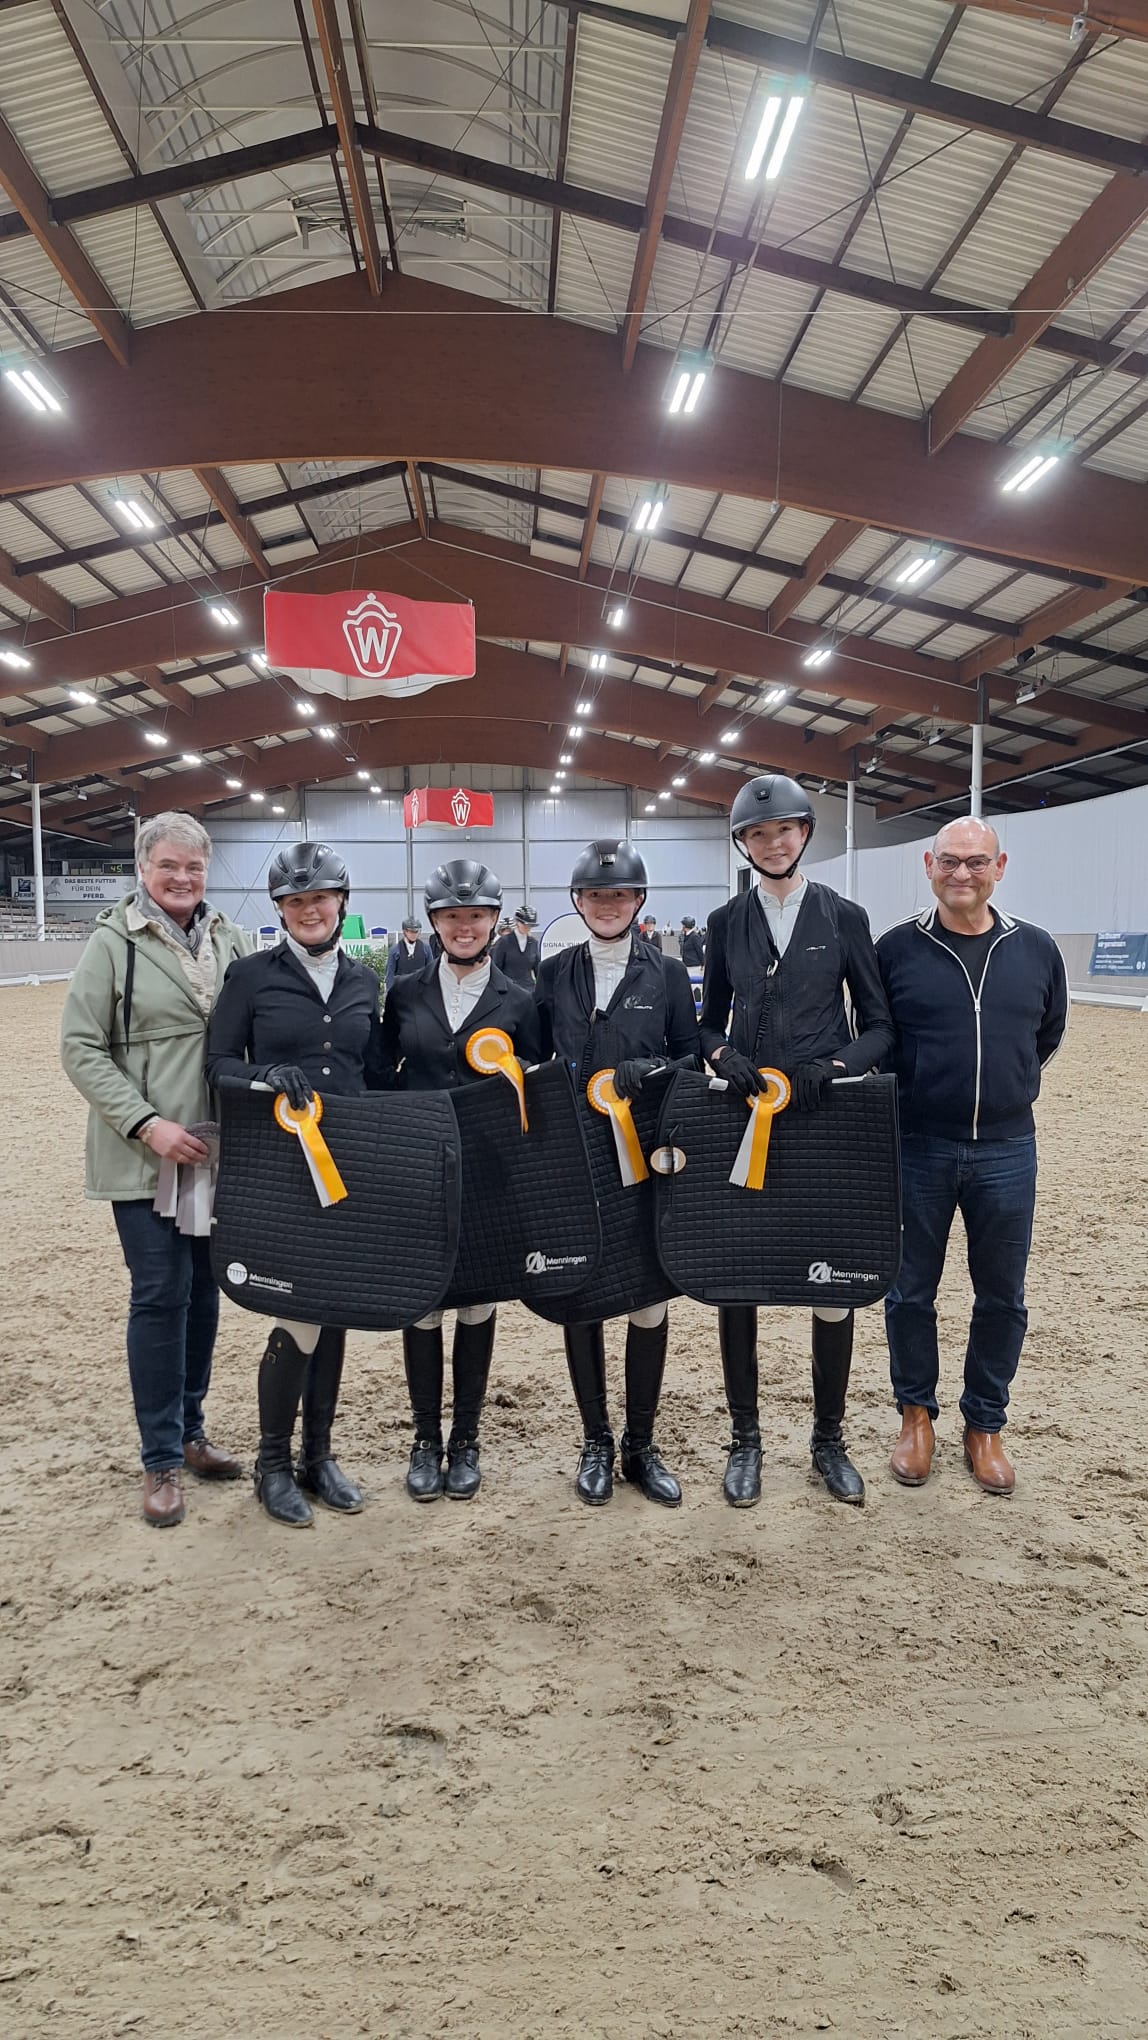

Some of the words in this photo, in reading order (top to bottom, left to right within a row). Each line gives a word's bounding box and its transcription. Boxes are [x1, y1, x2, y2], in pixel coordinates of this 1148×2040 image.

[355, 627, 389, 664] W
[455, 804, 467, 820] W
[546, 1255, 587, 1265] Menningen
[249, 1272, 293, 1289] Menningen
[832, 1270, 879, 1282] Menningen
